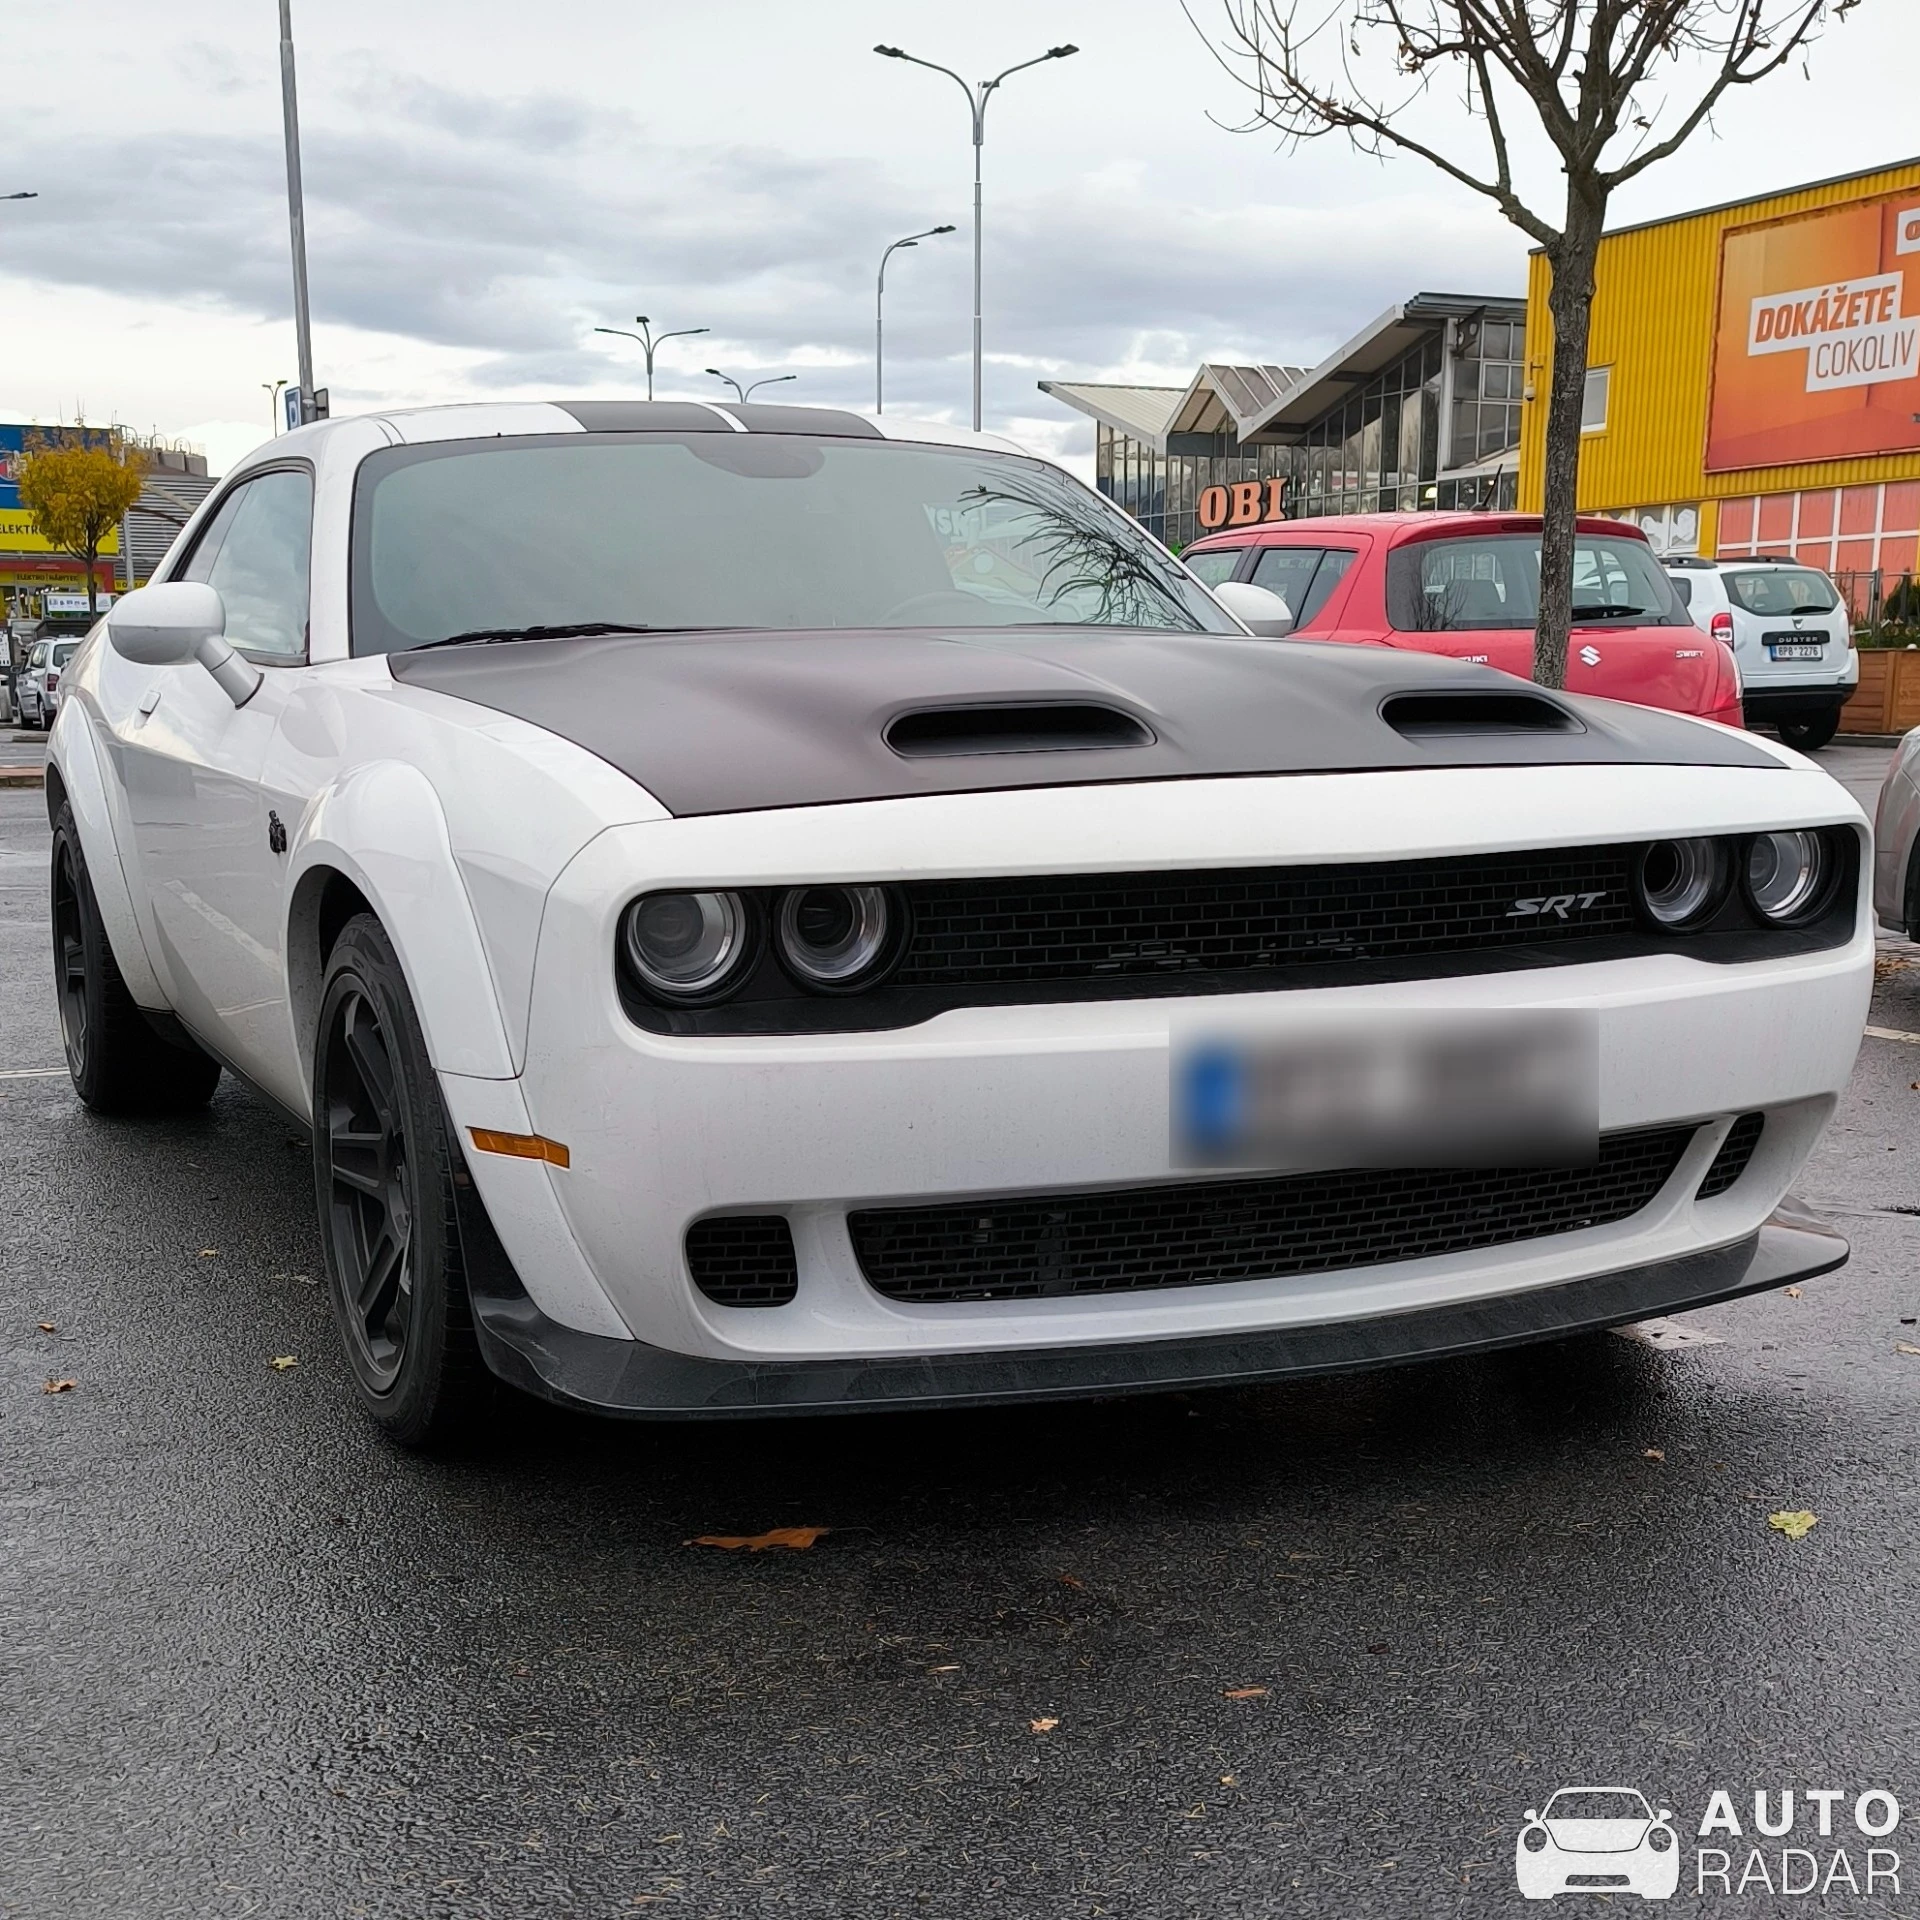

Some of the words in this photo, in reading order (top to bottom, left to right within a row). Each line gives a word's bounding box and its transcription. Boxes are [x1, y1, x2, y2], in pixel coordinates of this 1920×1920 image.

[1755, 285, 1896, 343] DOKÁŽETE
[1816, 328, 1915, 378] COKOLIV
[1199, 476, 1289, 529] OBI
[1505, 891, 1607, 919] SRT
